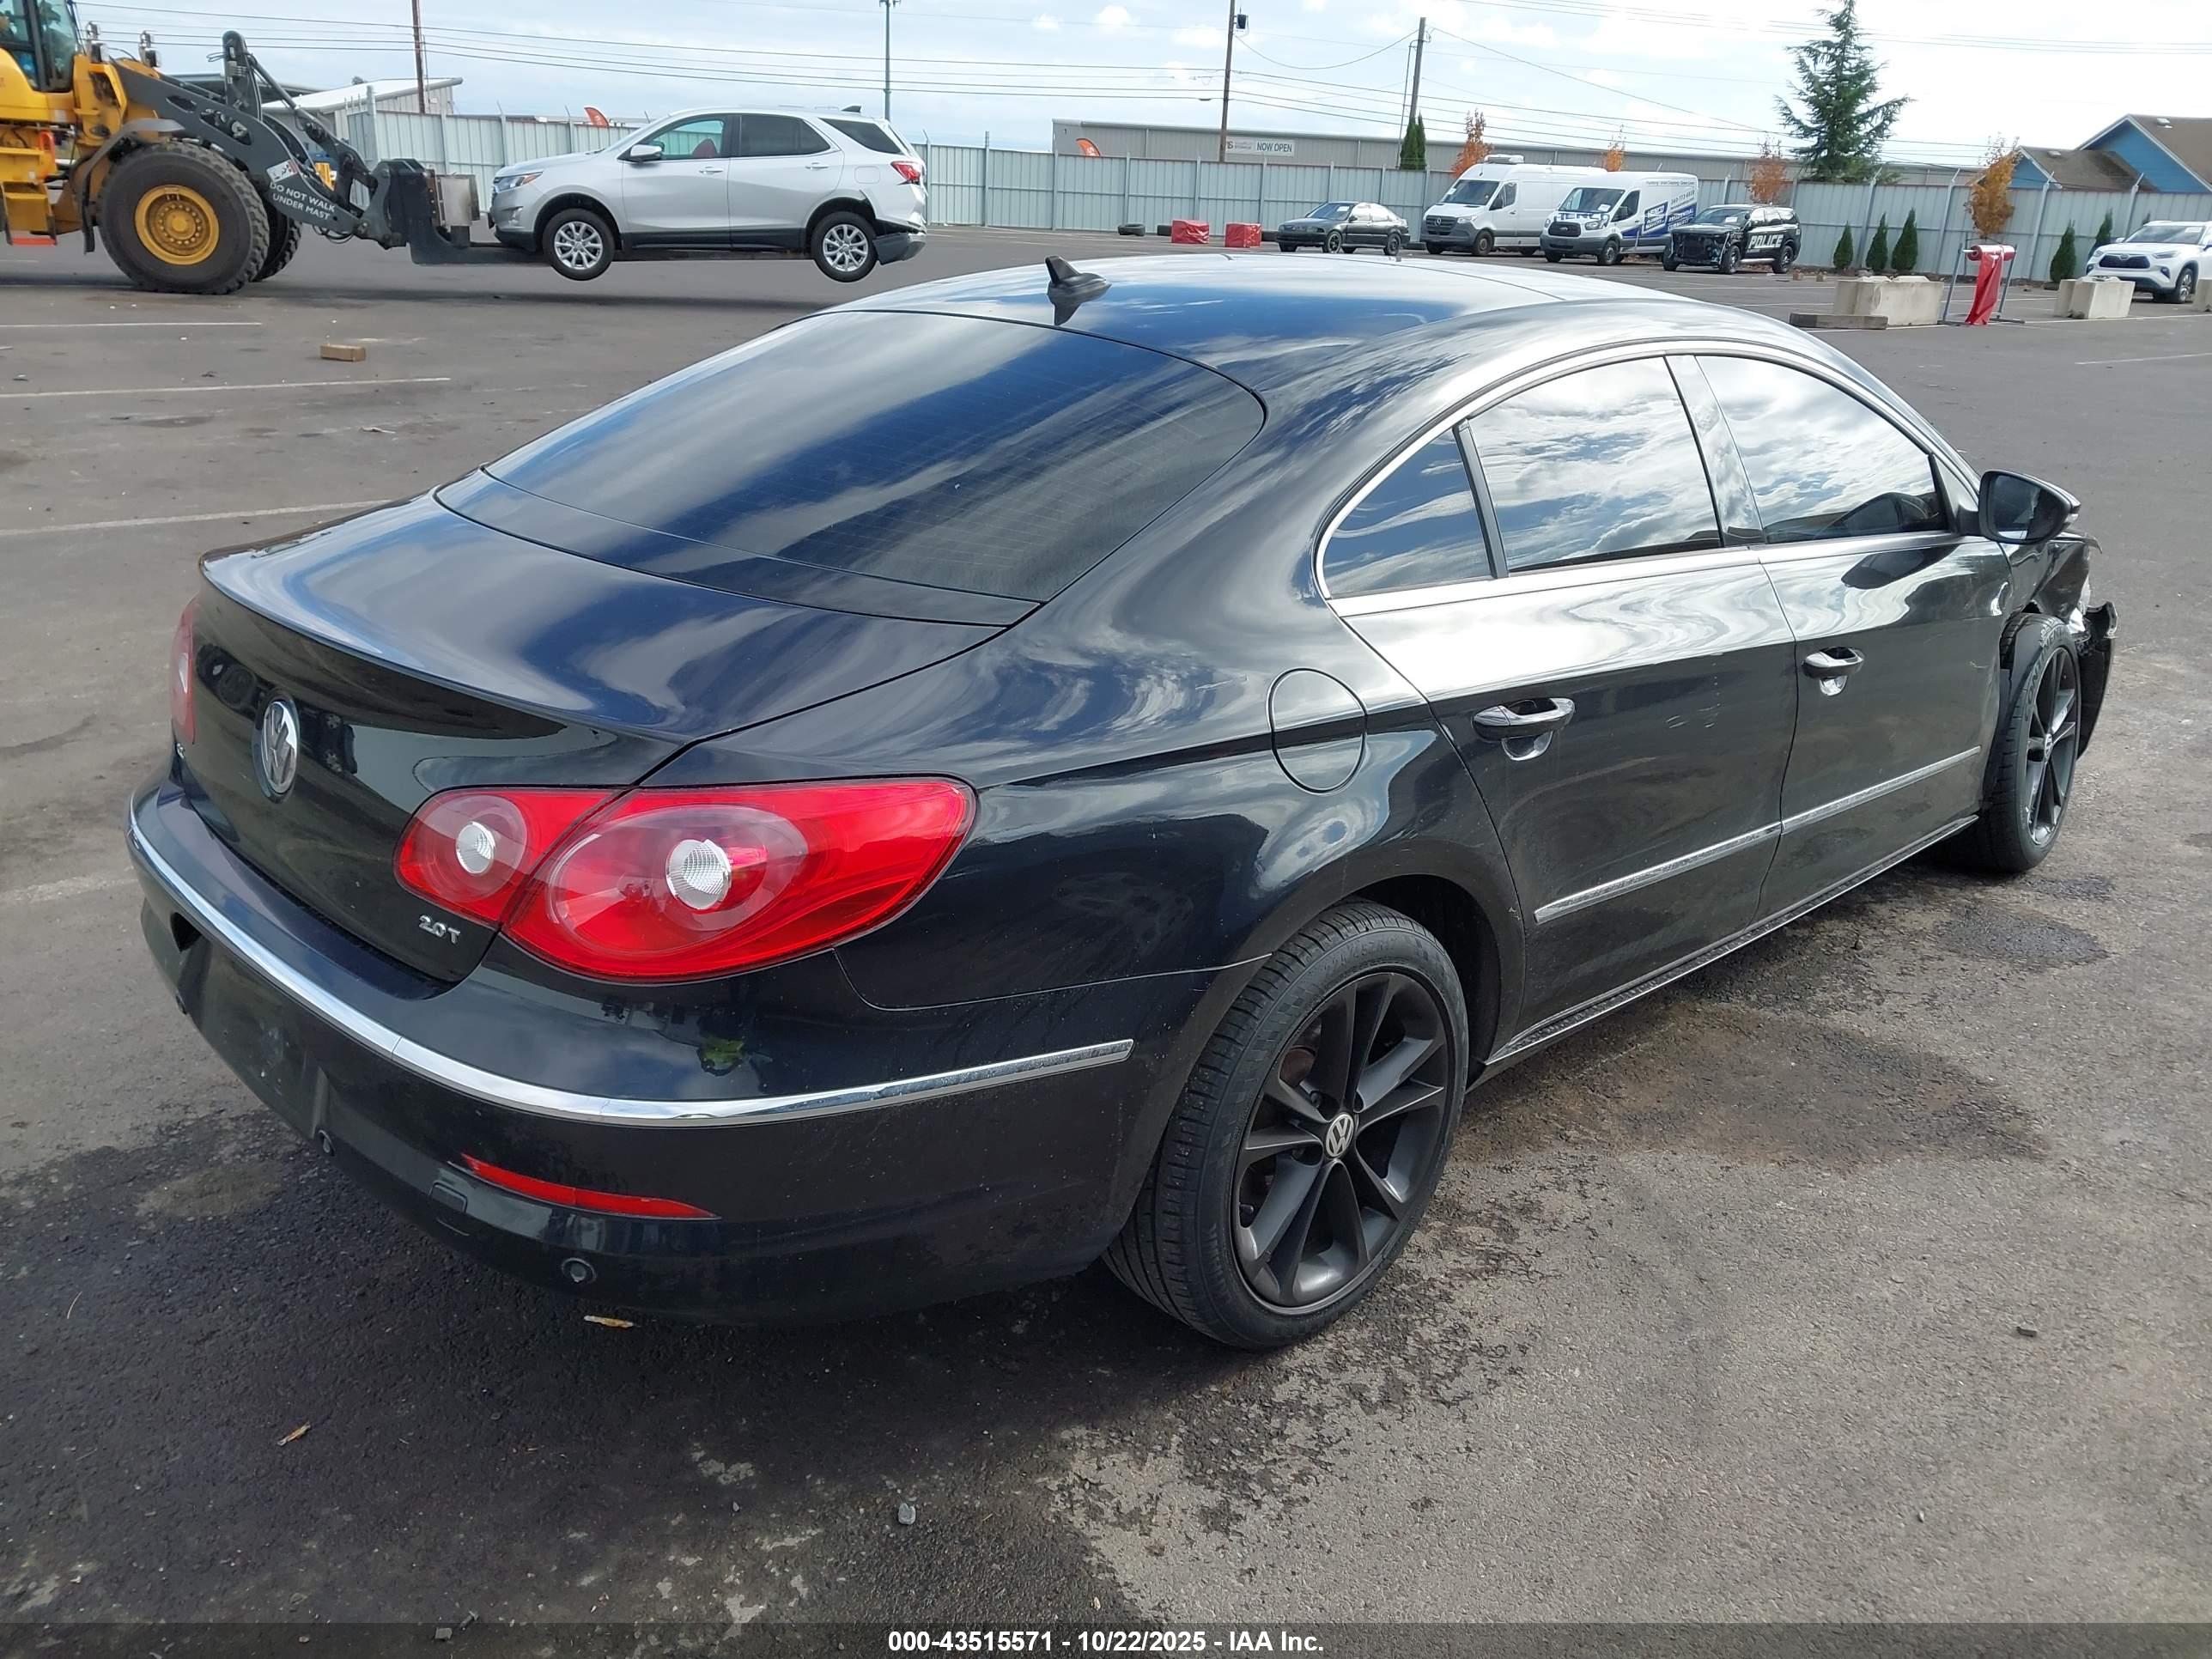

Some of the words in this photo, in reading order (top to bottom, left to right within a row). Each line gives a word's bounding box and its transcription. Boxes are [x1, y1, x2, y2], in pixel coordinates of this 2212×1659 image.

[1256, 142, 1273, 152] NOW
[1273, 143, 1292, 152] OPEN
[270, 182, 284, 192] DO
[286, 188, 307, 201] NOT
[309, 197, 335, 213] WALK
[273, 193, 304, 211] UNDER
[306, 206, 331, 220] MAST
[1748, 234, 1784, 249] POLICE
